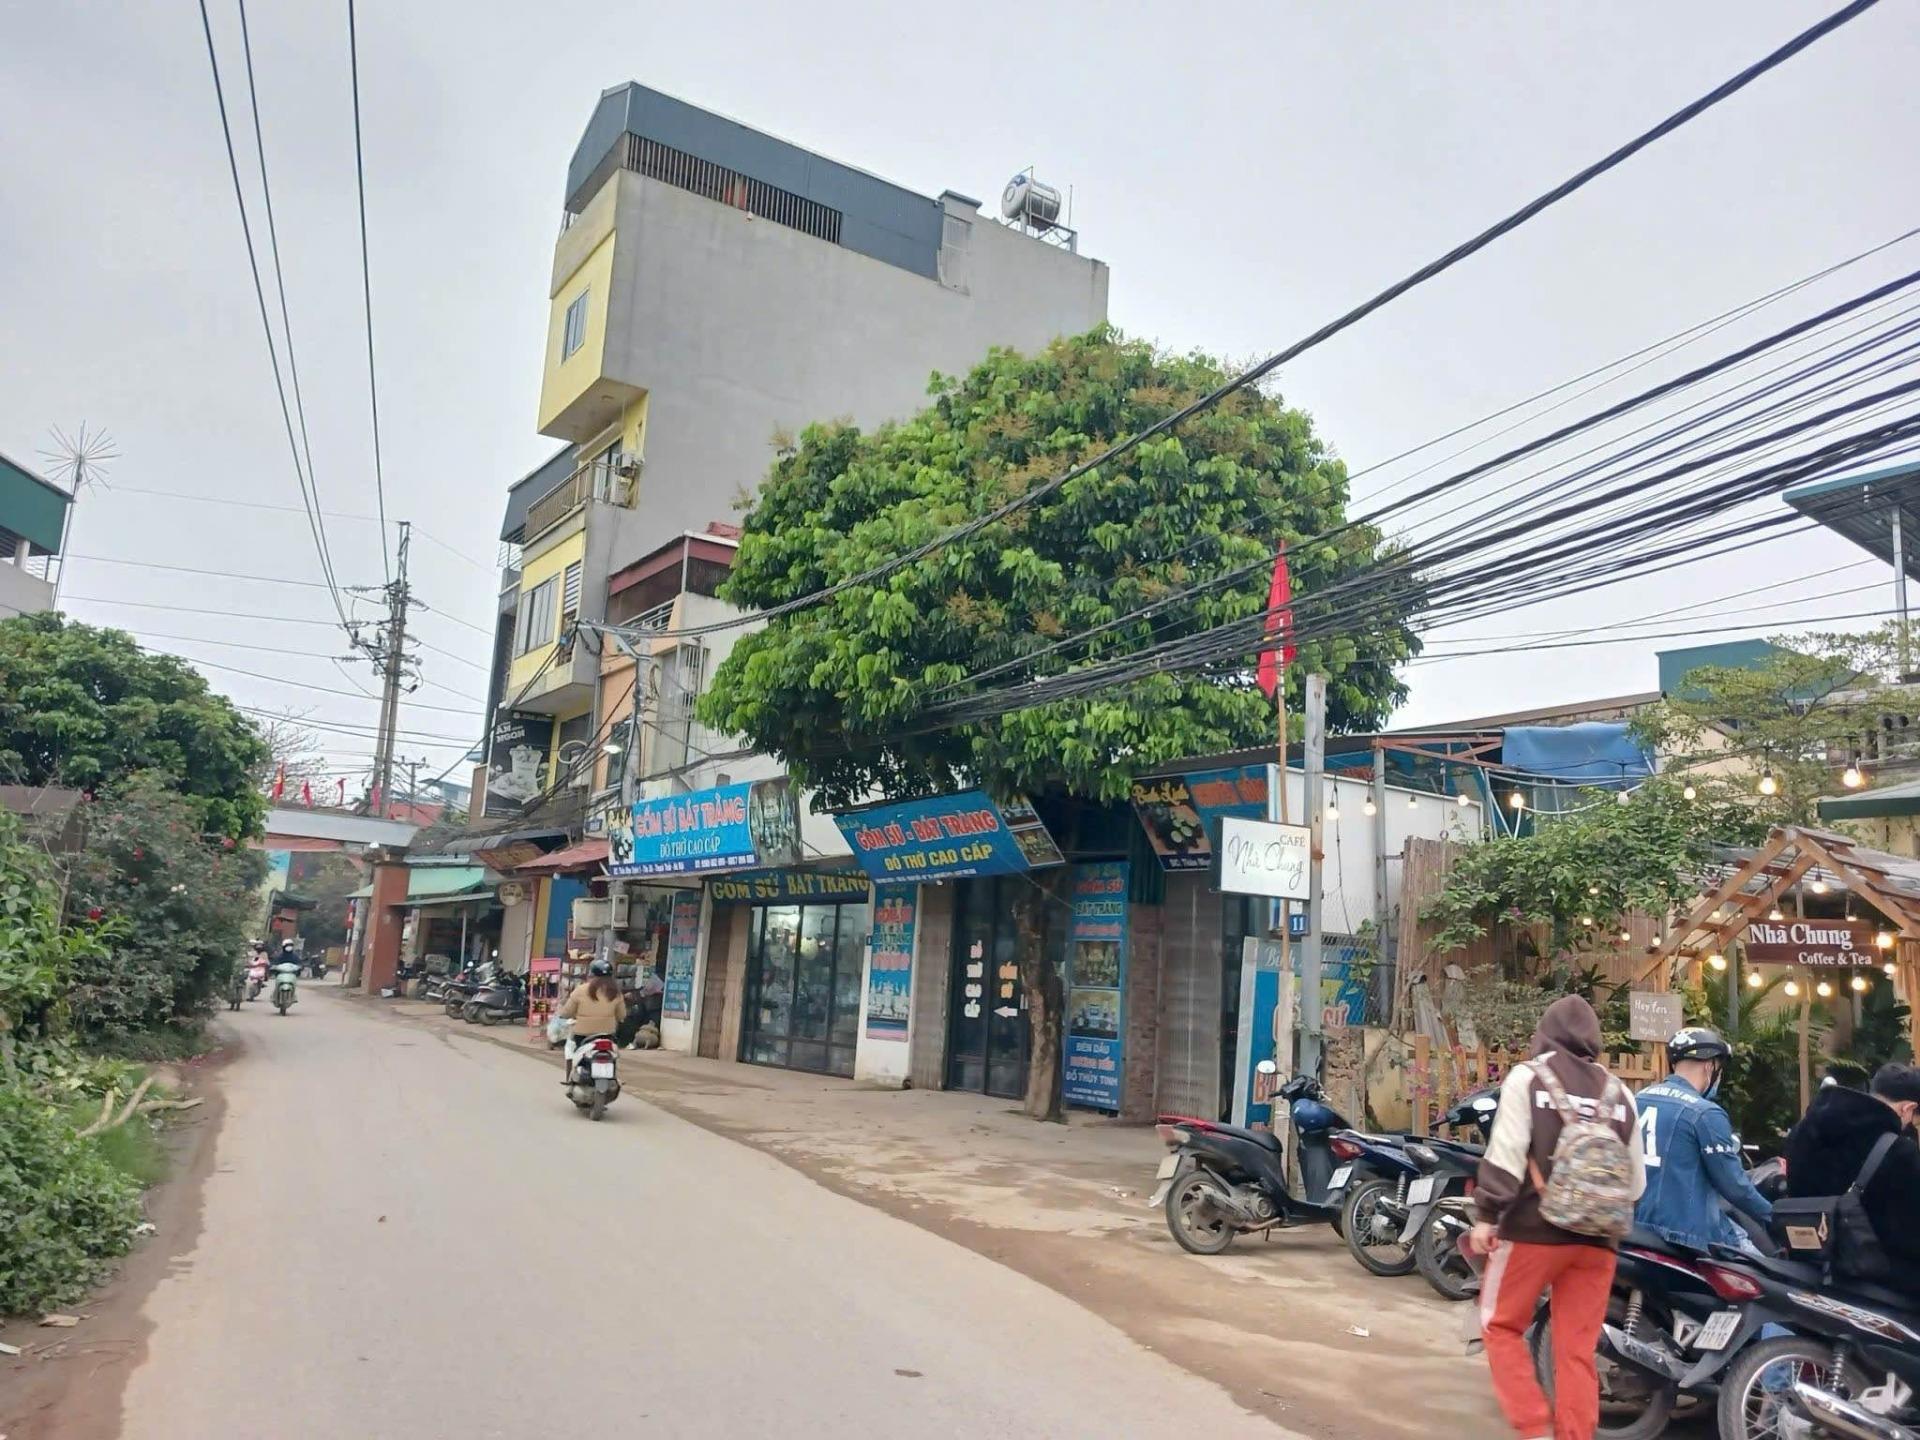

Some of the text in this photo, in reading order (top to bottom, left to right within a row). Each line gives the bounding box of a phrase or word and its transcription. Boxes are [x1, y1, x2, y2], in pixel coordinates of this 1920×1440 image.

[929, 848, 959, 866] CAO
[1292, 916, 1305, 931] 11
[1749, 923, 1854, 951] Nhà Chung
[1798, 951, 1873, 965] Coffee & Tea
